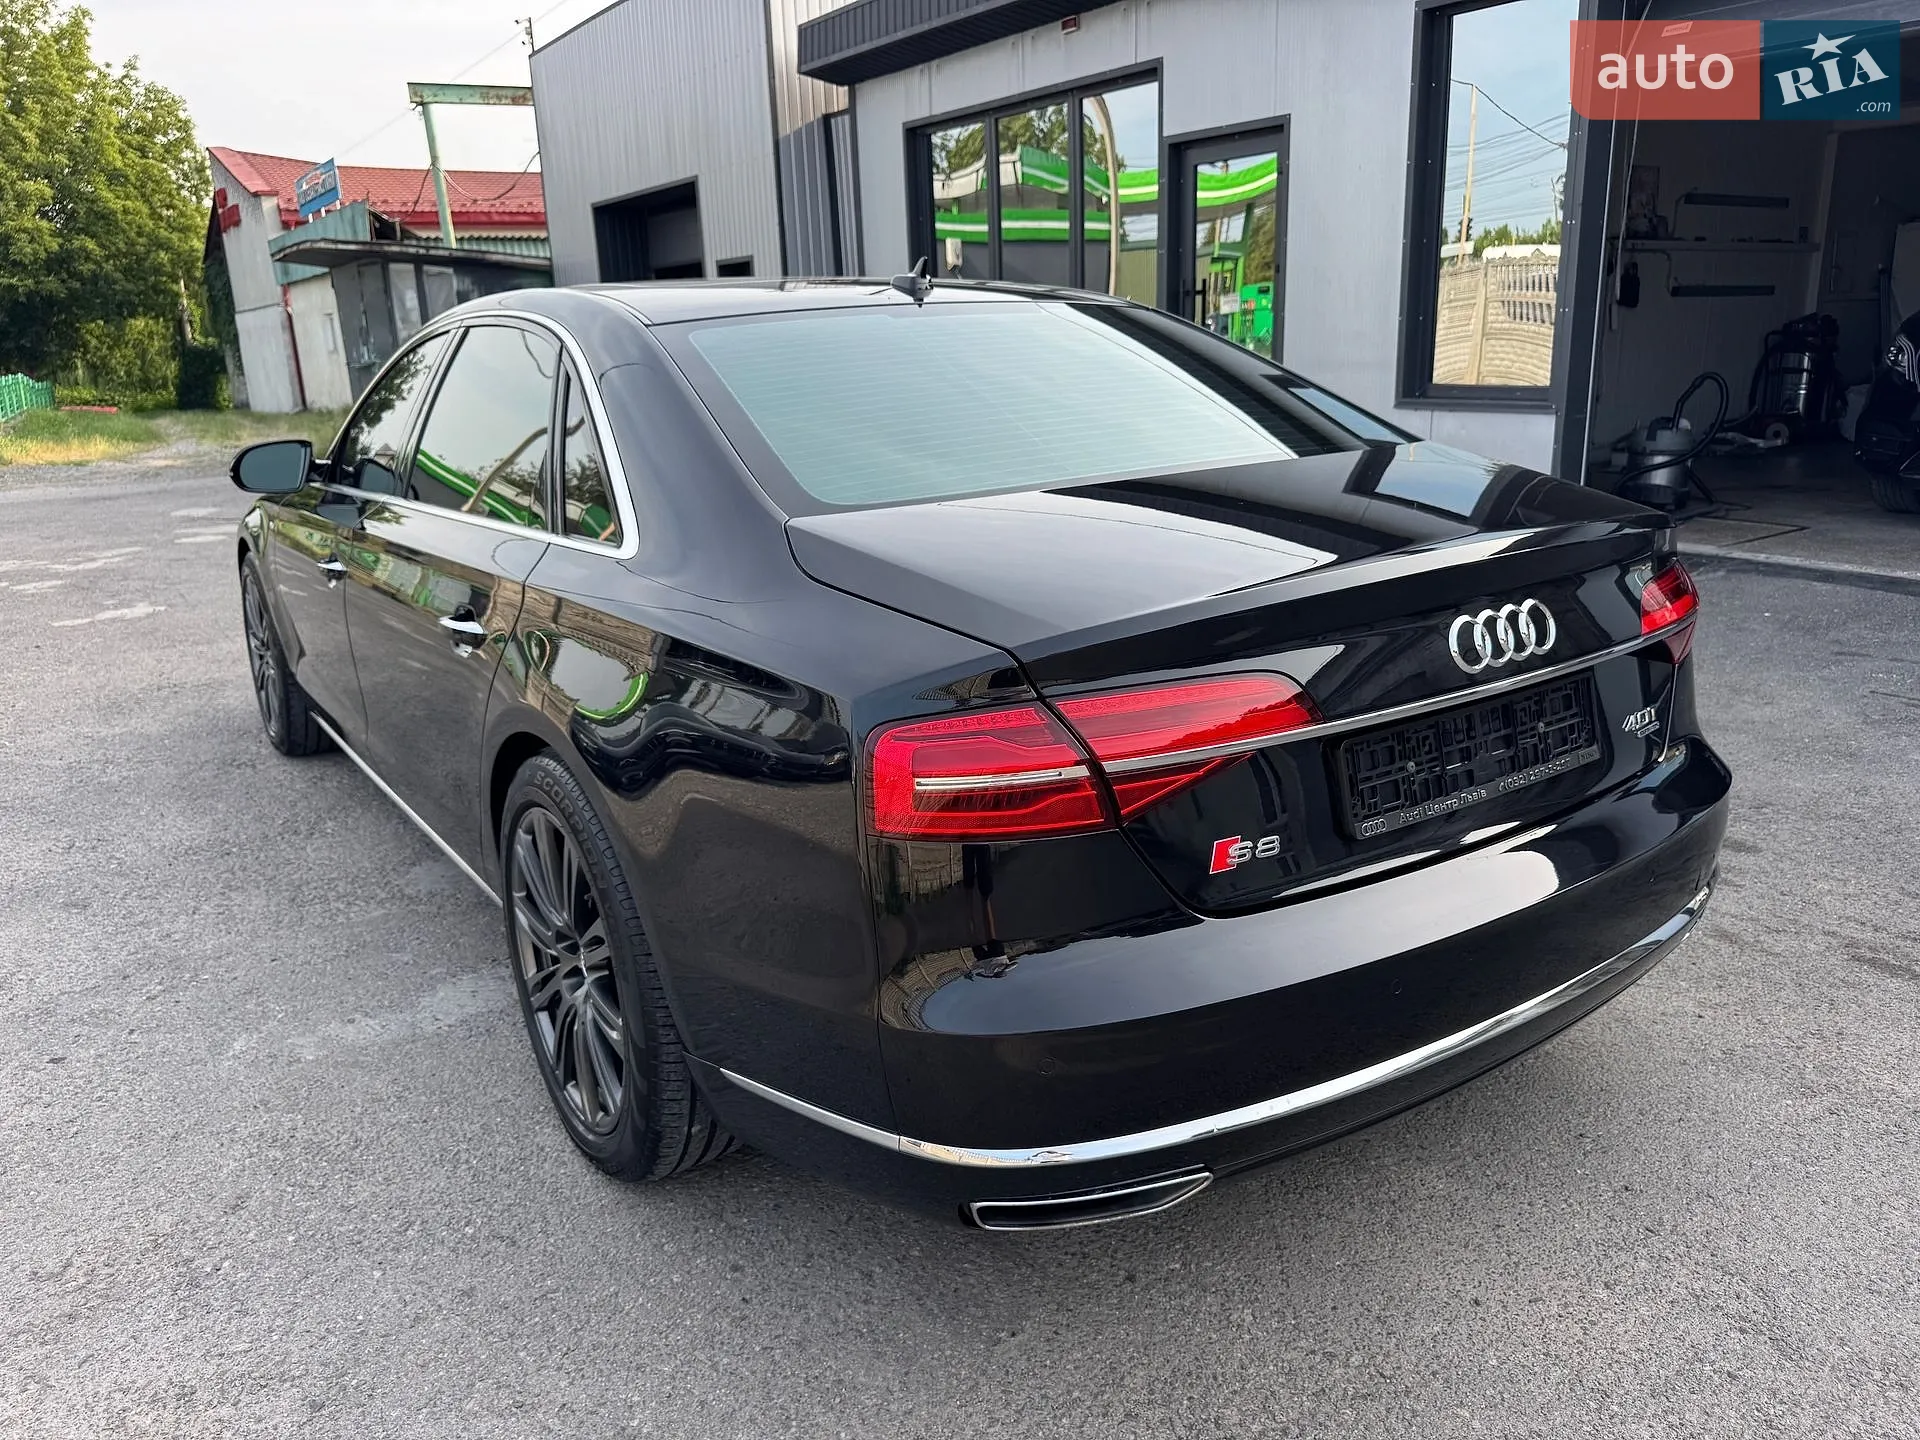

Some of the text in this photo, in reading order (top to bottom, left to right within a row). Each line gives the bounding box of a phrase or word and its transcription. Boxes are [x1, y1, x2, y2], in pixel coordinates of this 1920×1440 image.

[1400, 807, 1423, 824] Audi
[1424, 799, 1459, 817] Центр
[1226, 835, 1281, 866] S8
